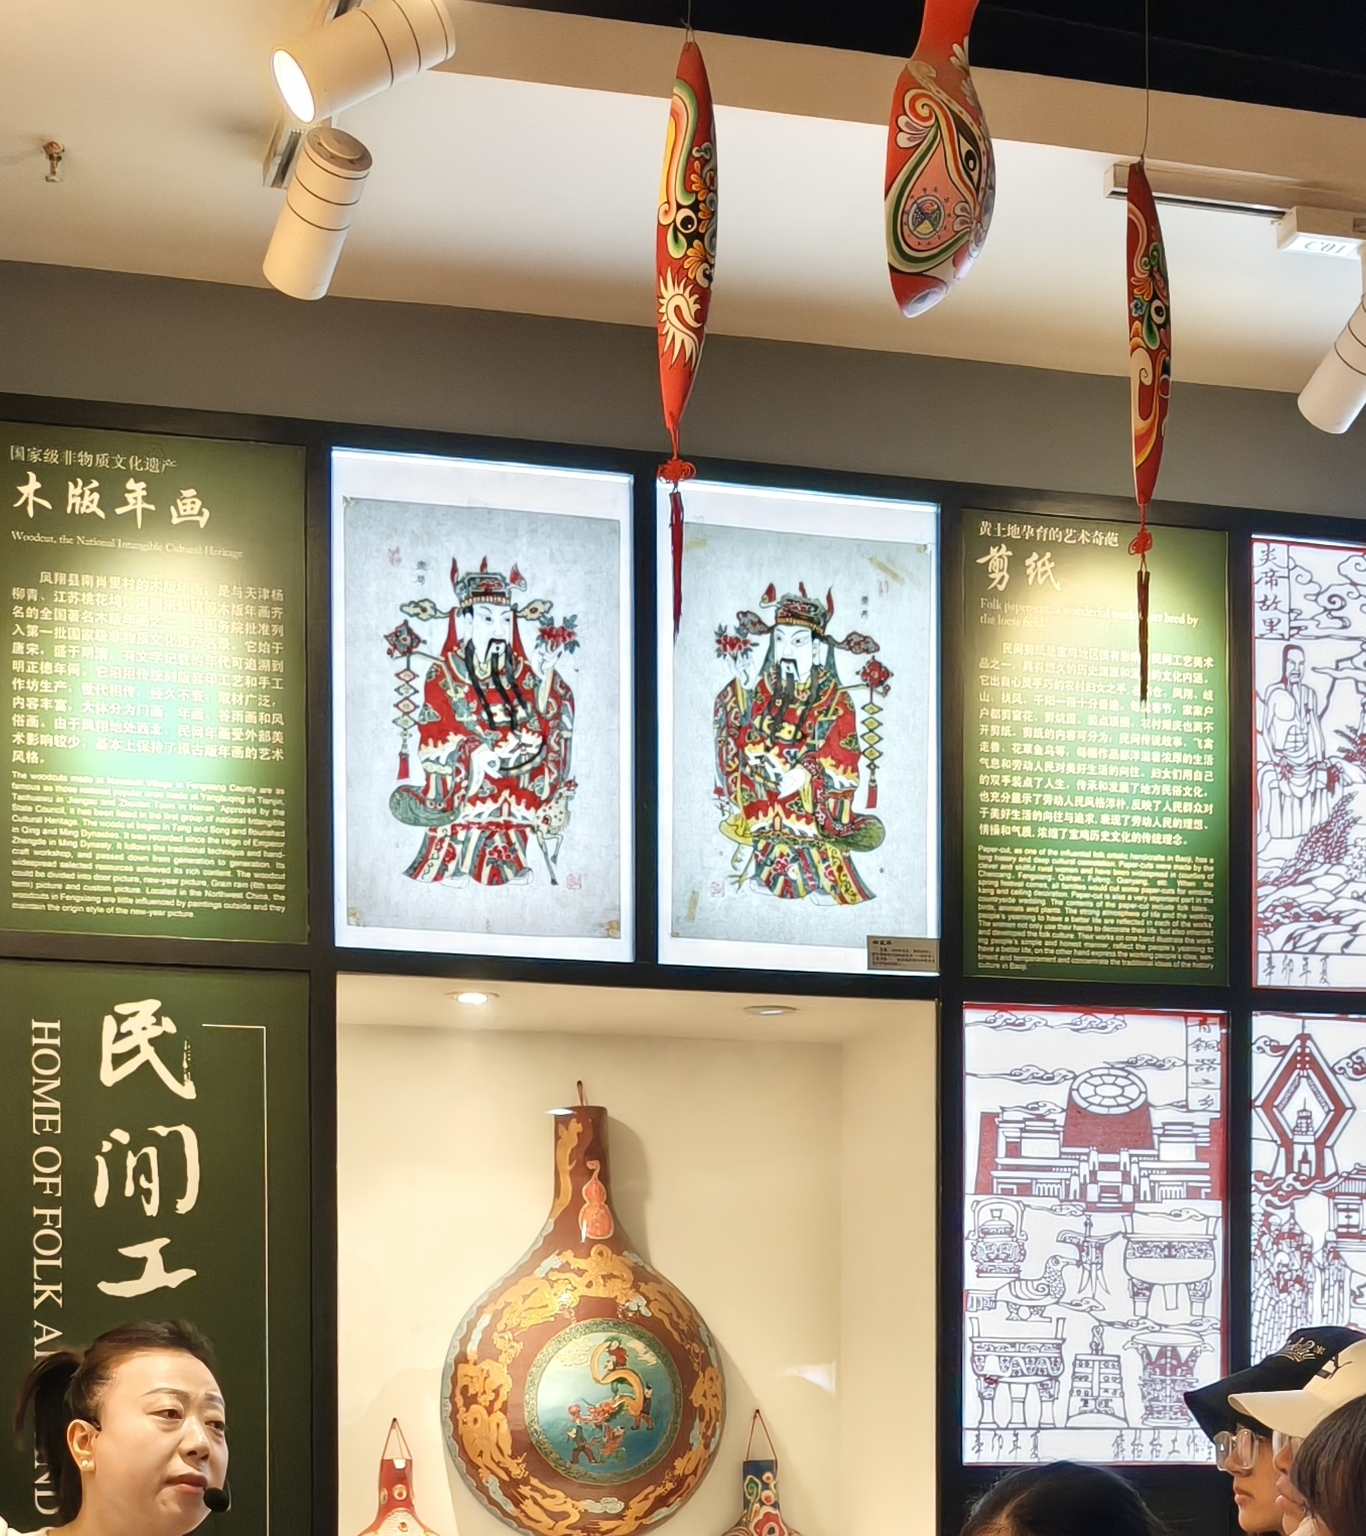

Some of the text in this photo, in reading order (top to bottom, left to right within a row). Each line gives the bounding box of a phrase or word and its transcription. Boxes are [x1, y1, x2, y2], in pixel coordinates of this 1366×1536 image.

[10, 446, 176, 473] 国家级非物质文化遗产
[12, 471, 210, 529] 木版年画
[975, 543, 1062, 592] 剪纸
[209, 825, 230, 835] Song
[31, 1018, 61, 1135] HOME
[32, 1147, 63, 1197] OF
[94, 998, 201, 1298] 民间工
[33, 1208, 63, 1308] FOLK
